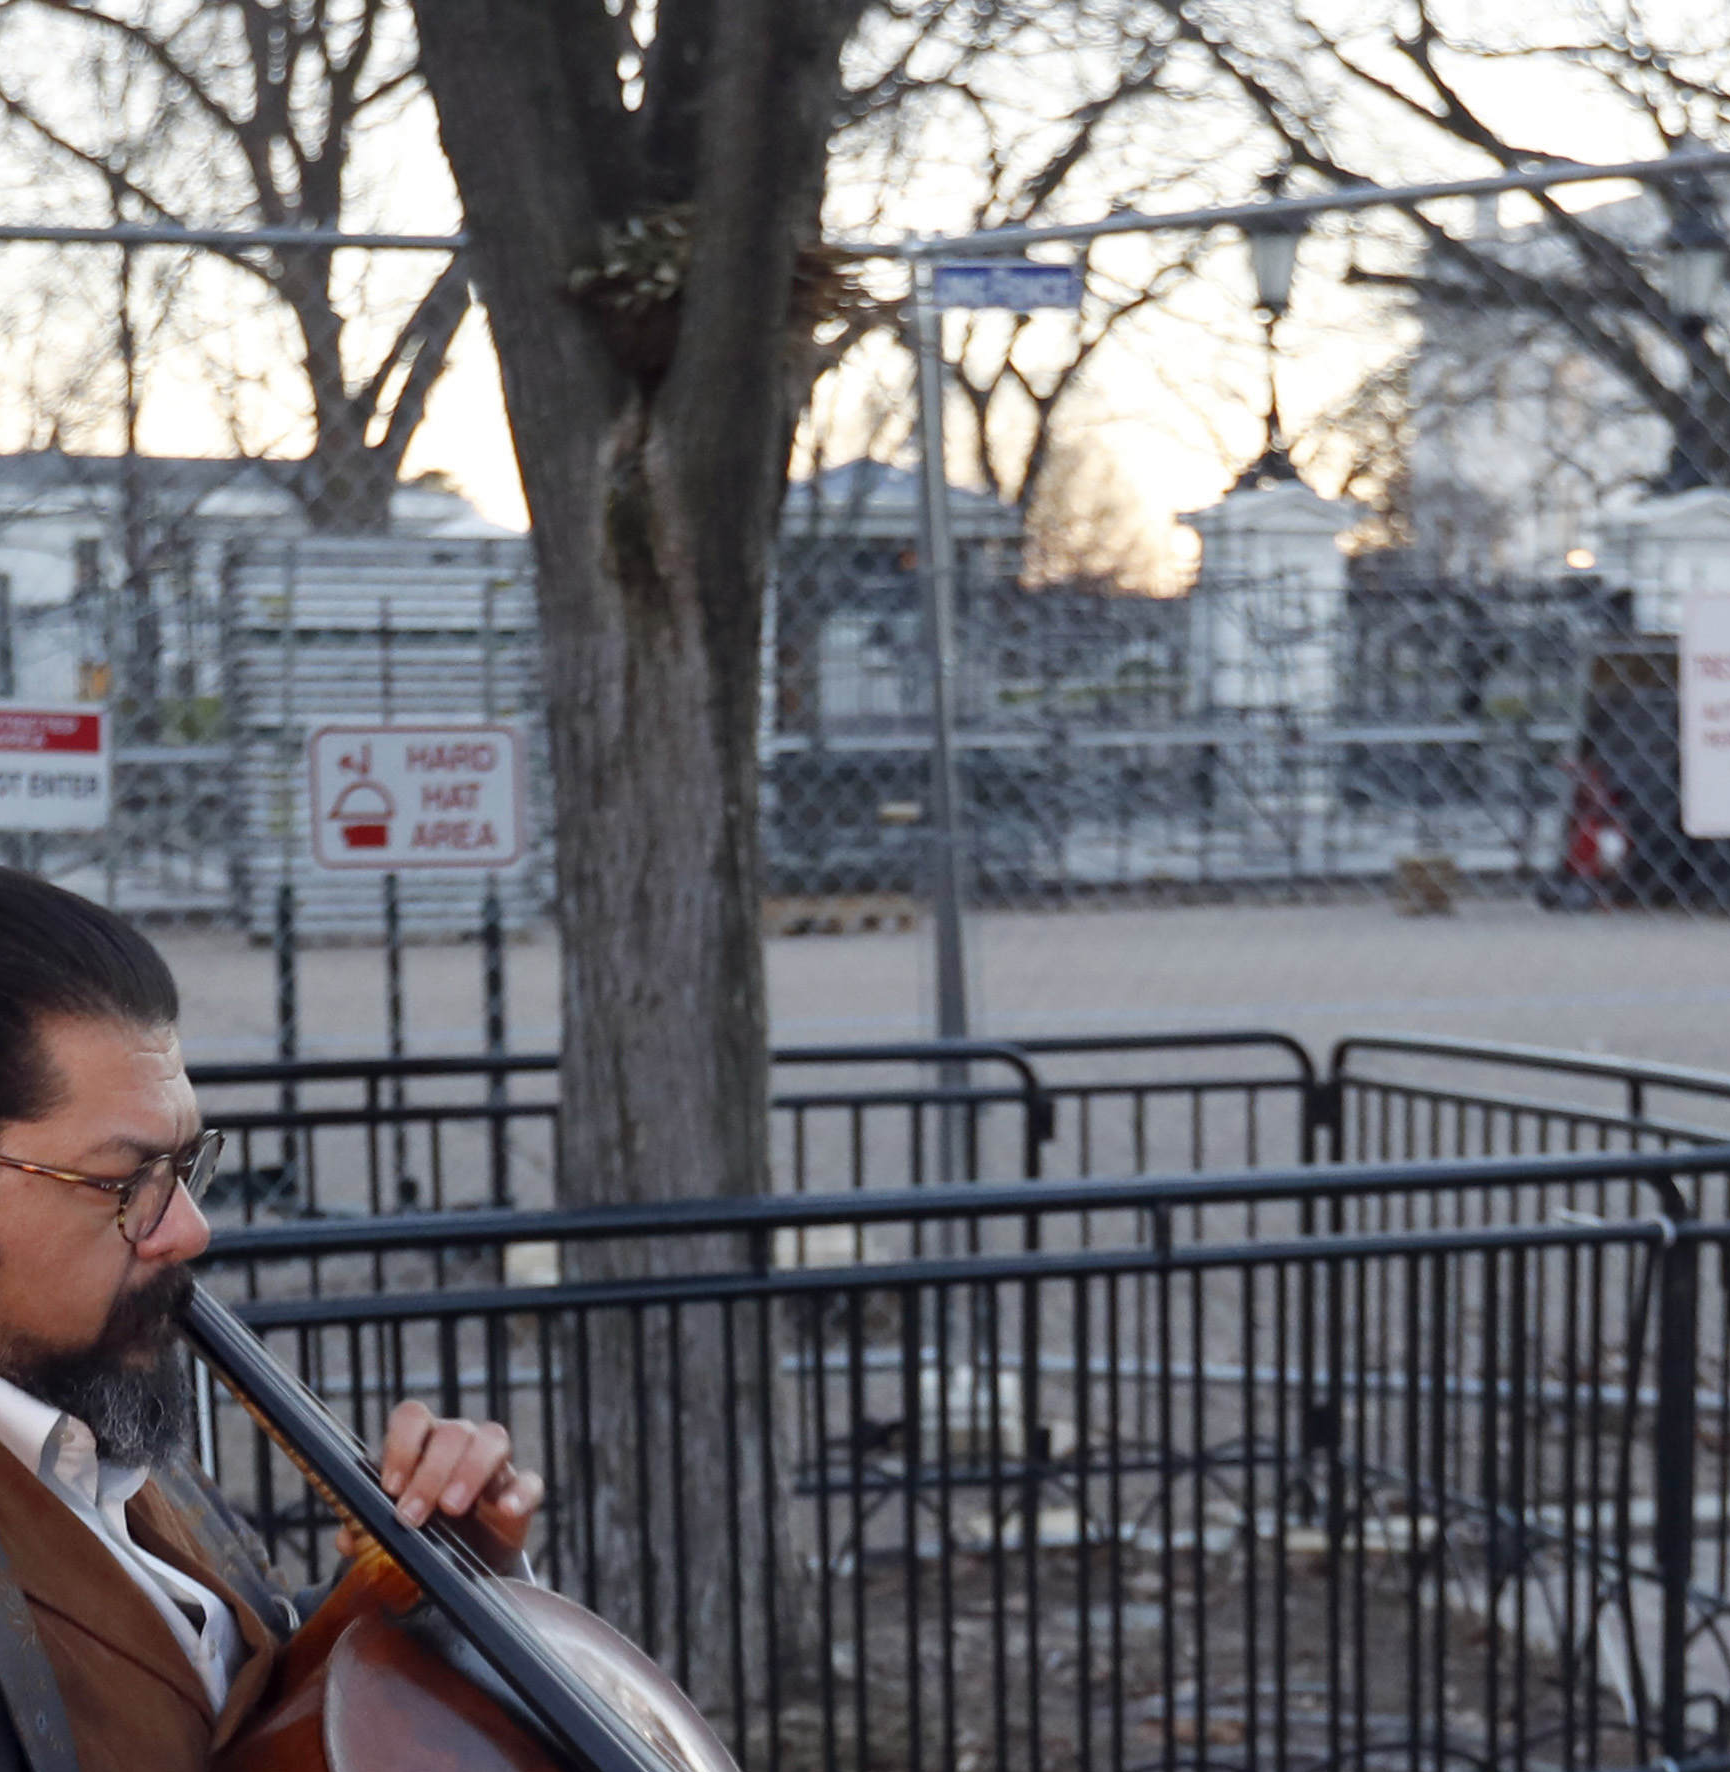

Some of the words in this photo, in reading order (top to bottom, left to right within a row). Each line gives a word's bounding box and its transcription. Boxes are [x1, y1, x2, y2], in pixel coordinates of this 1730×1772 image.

[404, 742, 499, 773] HARD
[28, 771, 99, 800] ENTER
[420, 780, 482, 812] HAT
[408, 820, 499, 851] AREA
